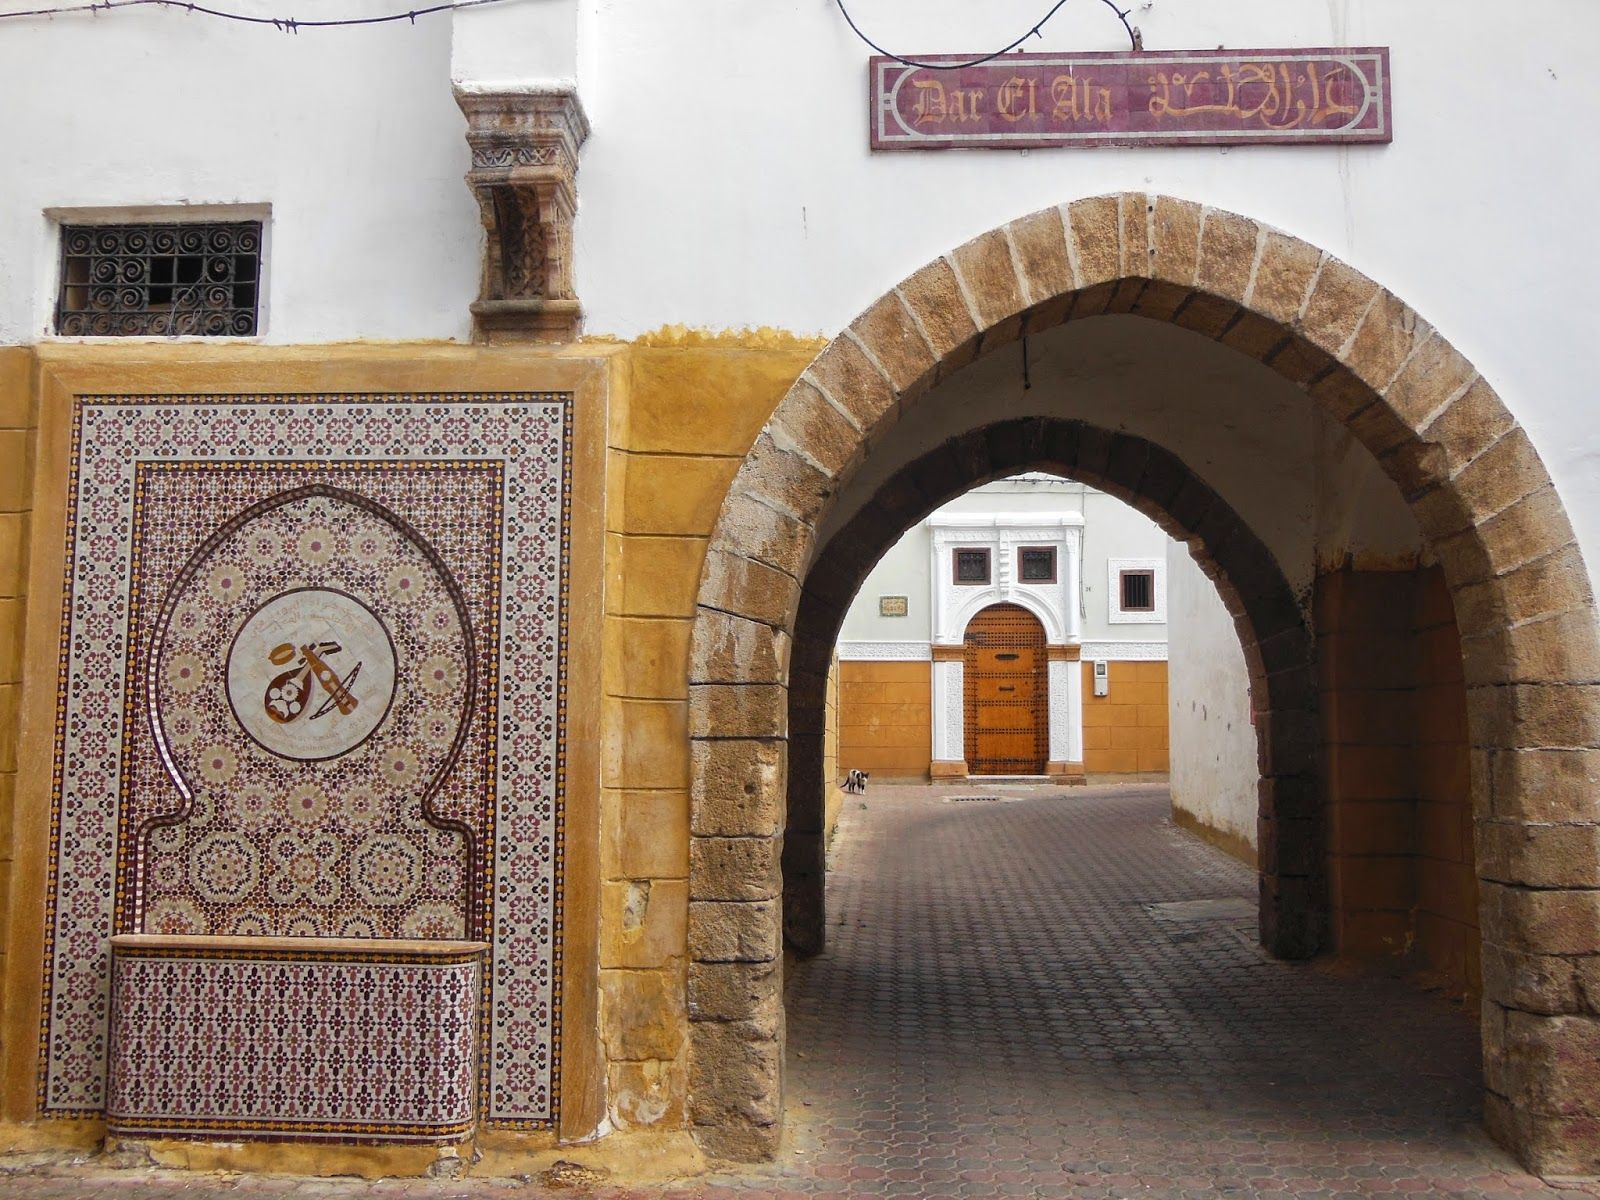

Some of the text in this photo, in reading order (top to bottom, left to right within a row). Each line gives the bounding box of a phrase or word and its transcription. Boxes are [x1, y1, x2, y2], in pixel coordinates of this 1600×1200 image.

[912, 74, 1113, 127] Dar El Ala
